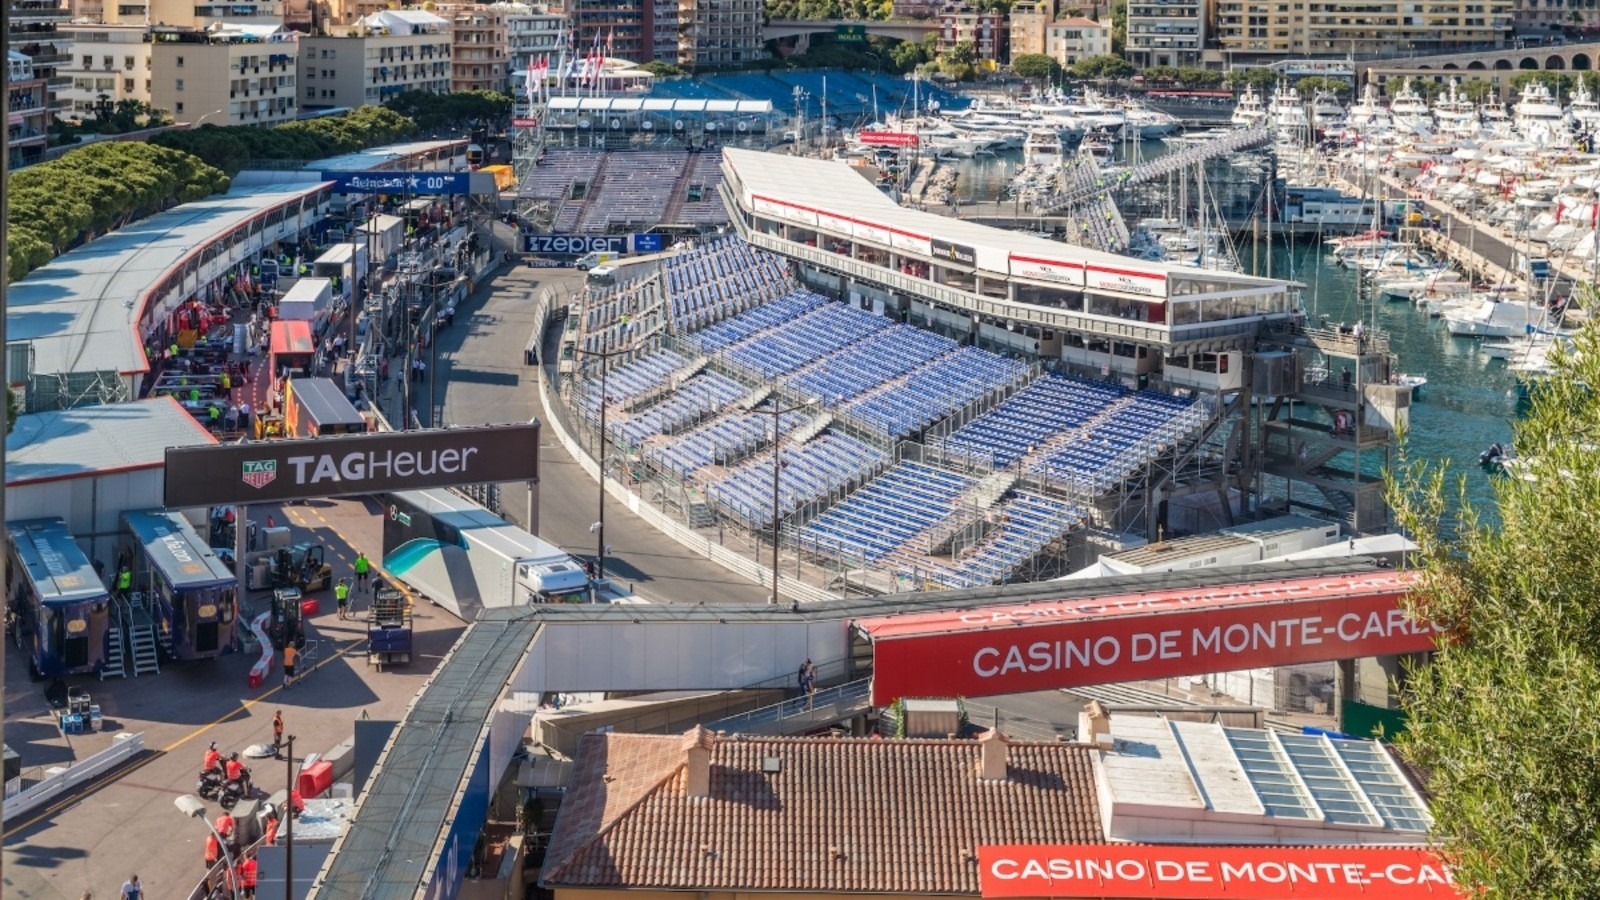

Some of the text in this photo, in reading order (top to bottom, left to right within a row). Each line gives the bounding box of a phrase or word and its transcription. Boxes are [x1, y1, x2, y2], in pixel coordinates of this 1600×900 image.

[539, 236, 621, 253] zepter
[246, 462, 273, 472] TAG
[245, 472, 274, 486] HEUER
[973, 635, 1121, 677] CASINO
[1132, 630, 1182, 662] DE
[991, 858, 1145, 880] CASINO
[1154, 860, 1214, 882] DE
